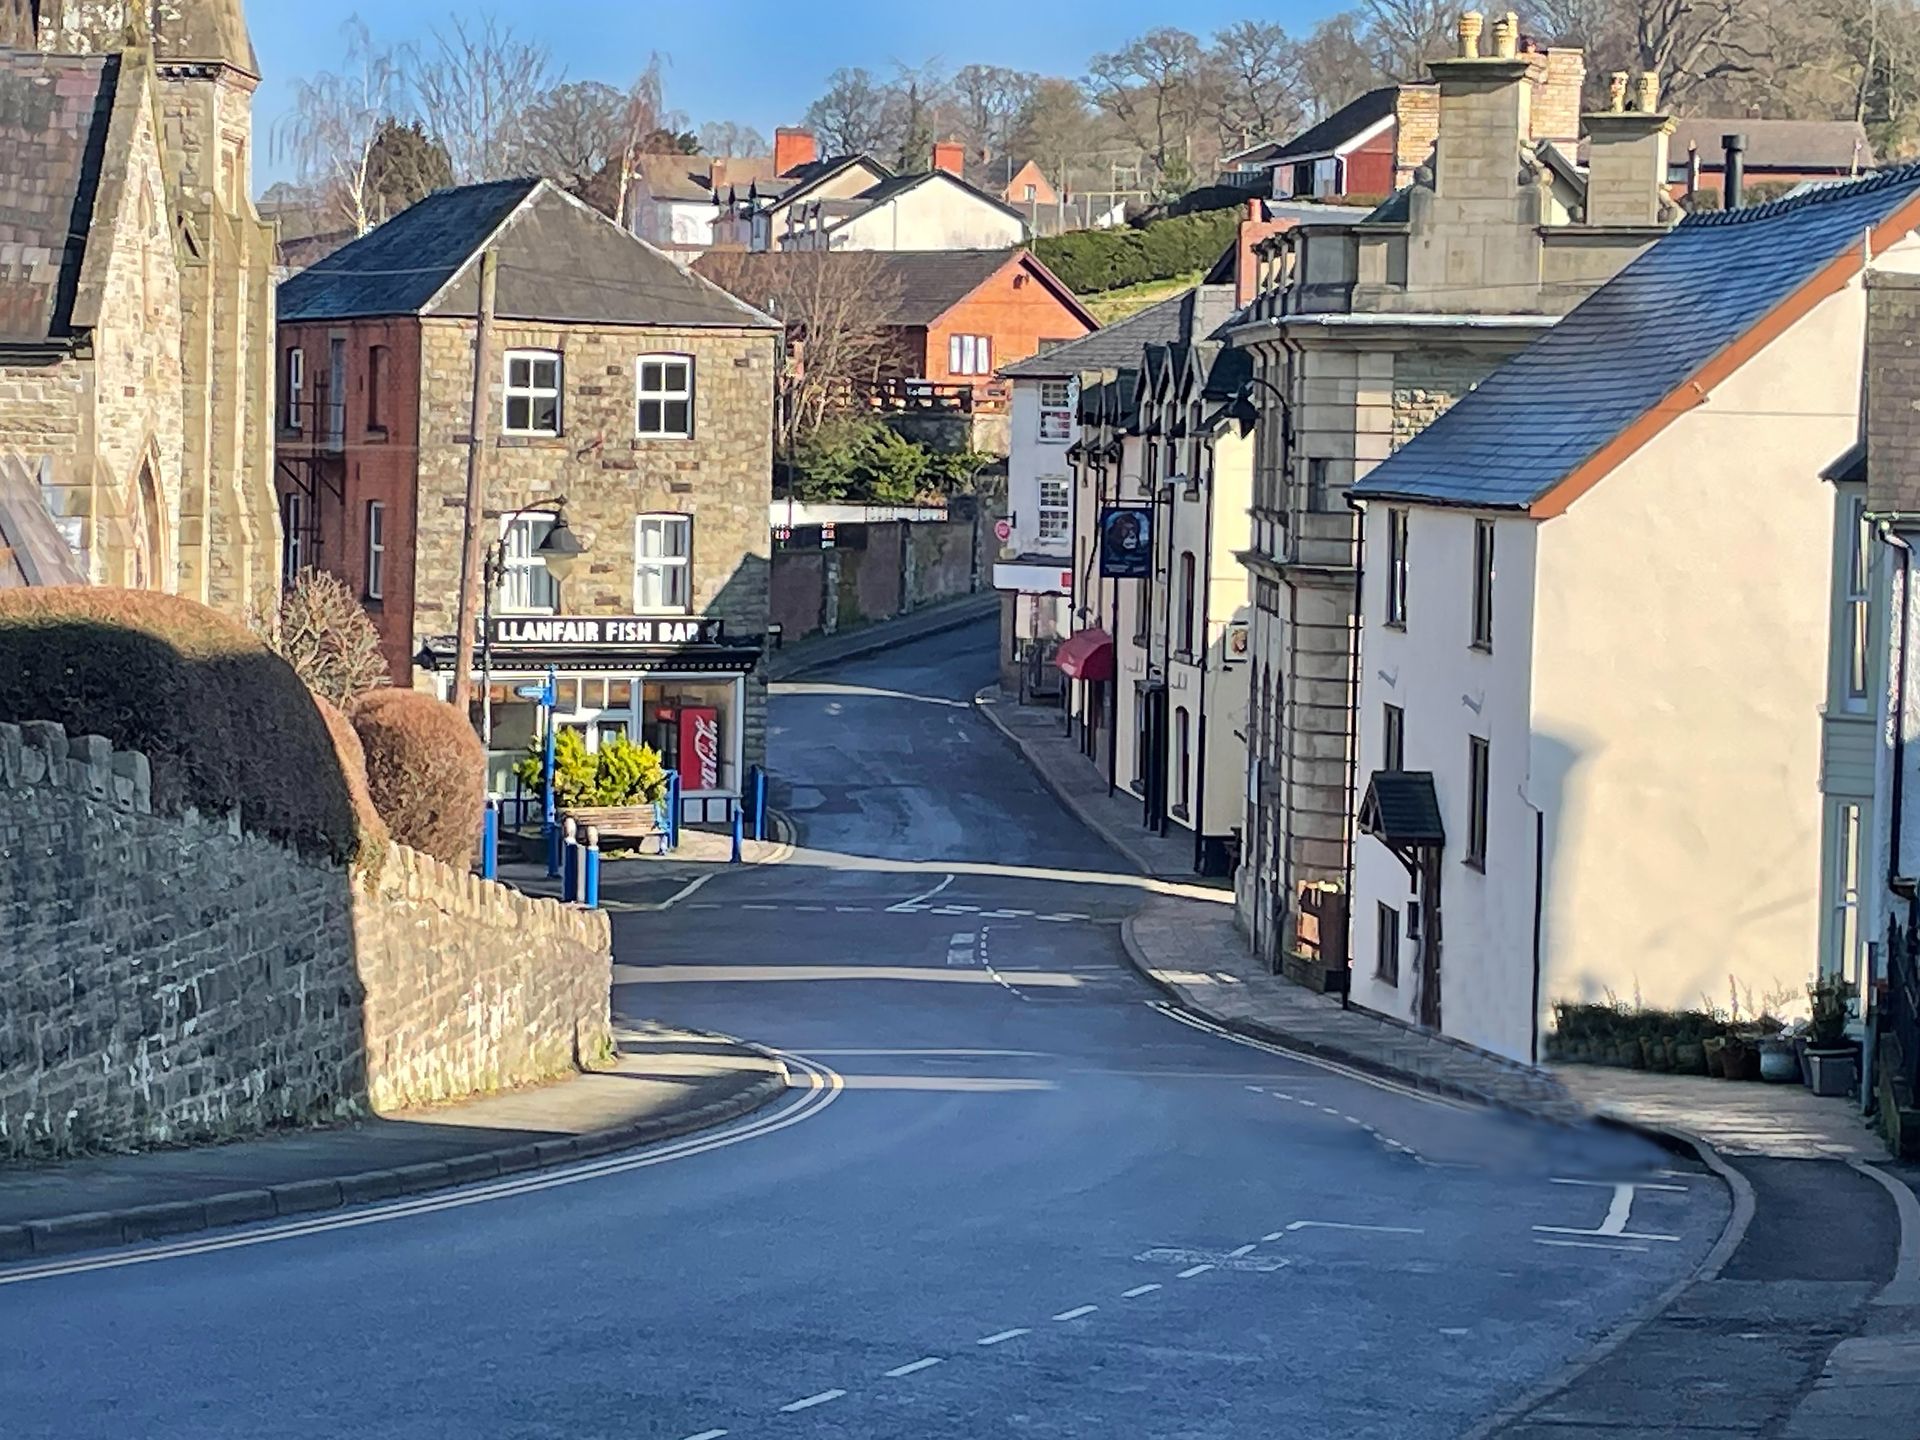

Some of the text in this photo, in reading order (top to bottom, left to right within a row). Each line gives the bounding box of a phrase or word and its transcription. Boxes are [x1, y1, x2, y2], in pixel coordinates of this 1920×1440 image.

[498, 621, 699, 642] LLANFAIR FISH BAR
